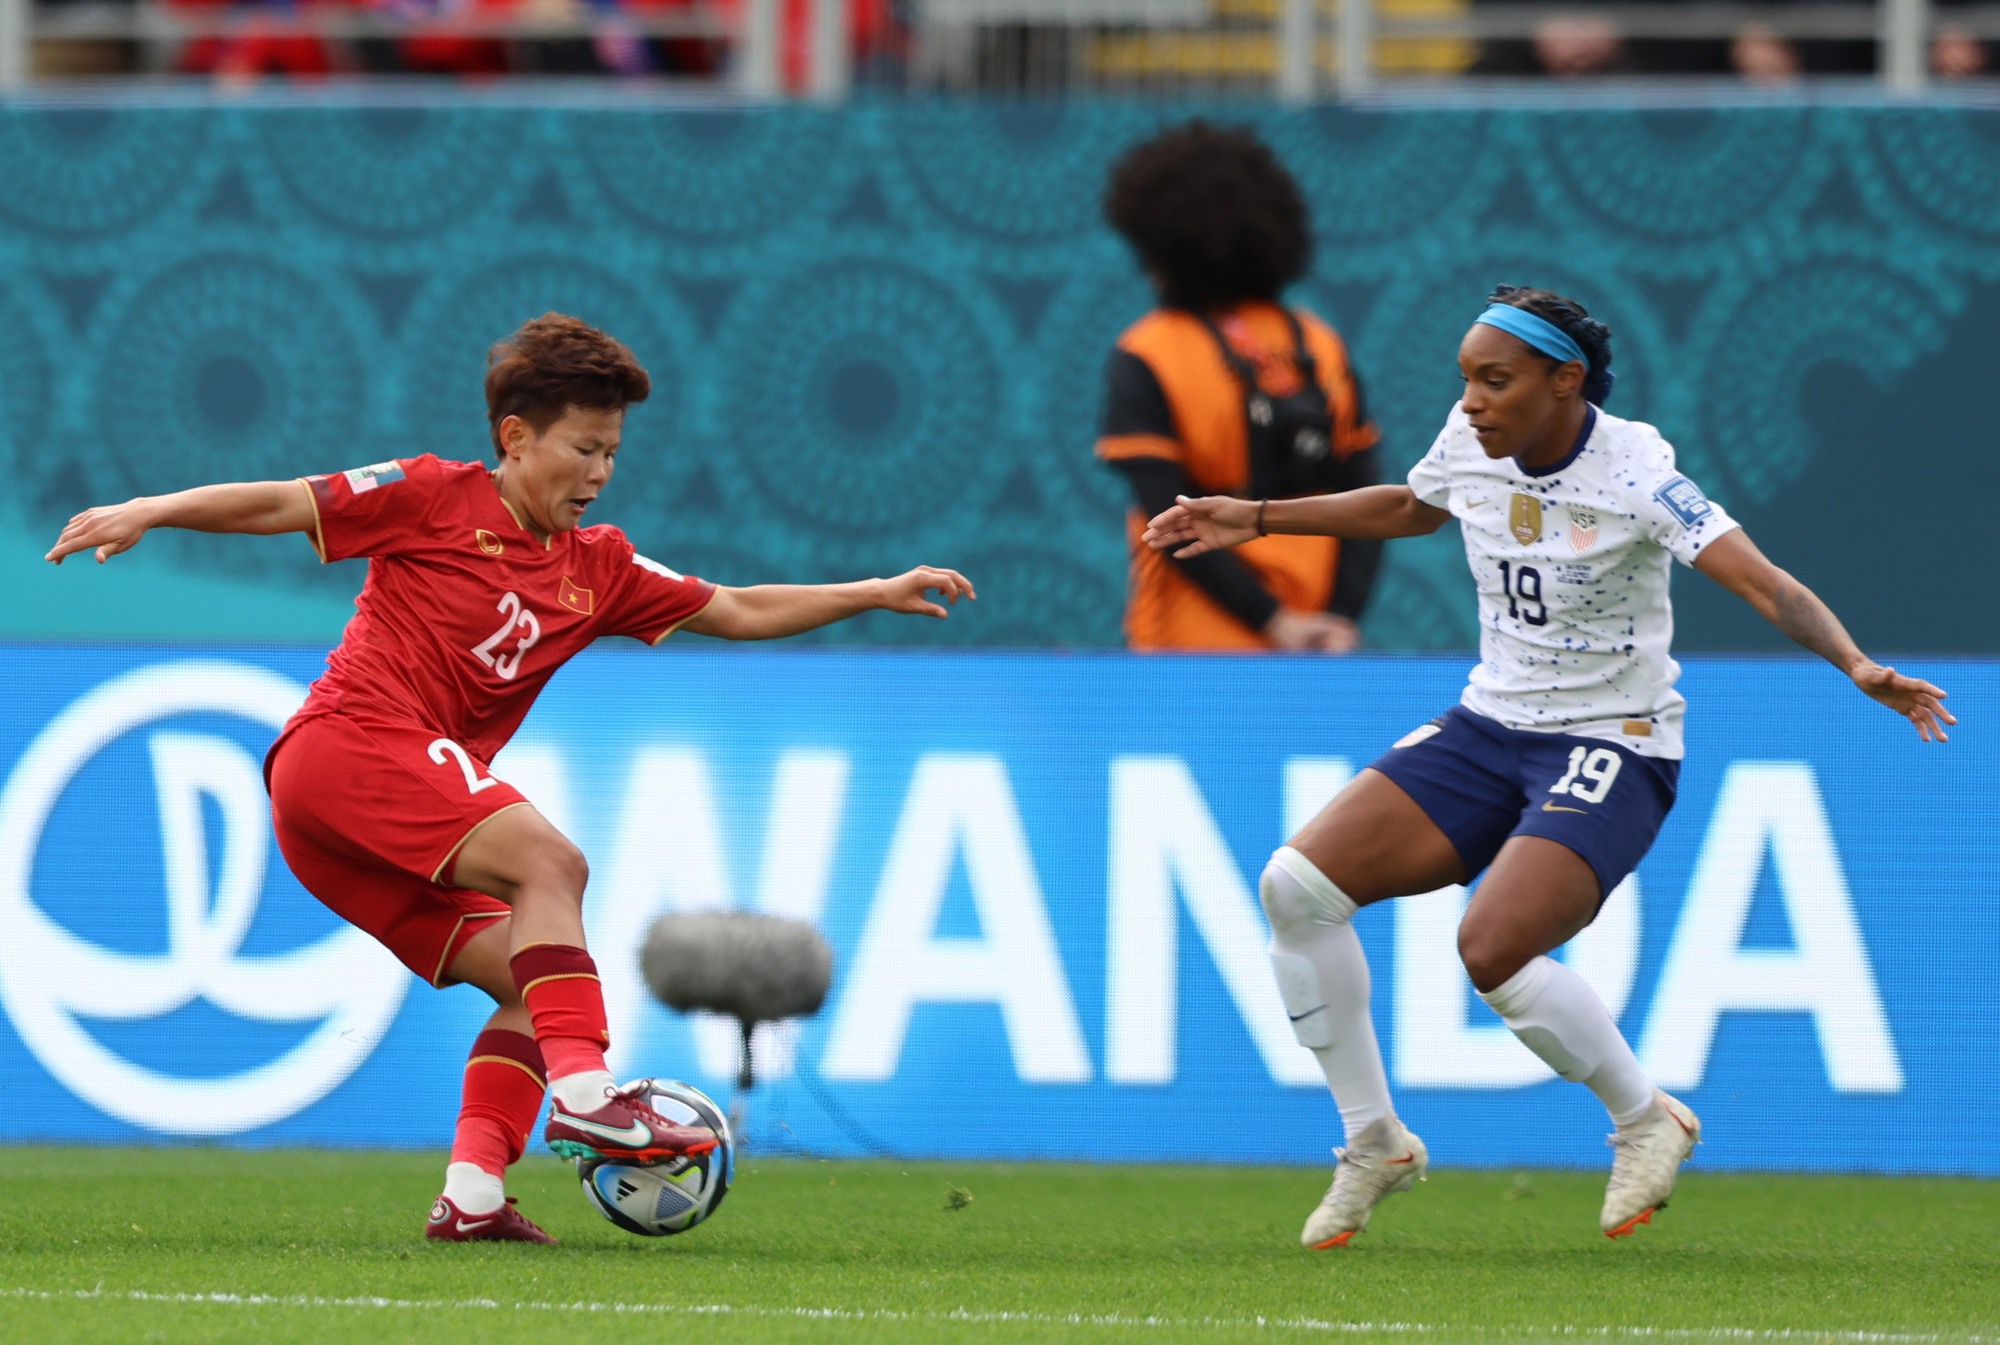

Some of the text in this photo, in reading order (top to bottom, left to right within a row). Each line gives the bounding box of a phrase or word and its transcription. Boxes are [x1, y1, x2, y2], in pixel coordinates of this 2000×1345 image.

[1497, 560, 1548, 627] 19
[470, 591, 540, 681] 23
[427, 738, 504, 795] 2
[1548, 745, 1622, 804] 19
